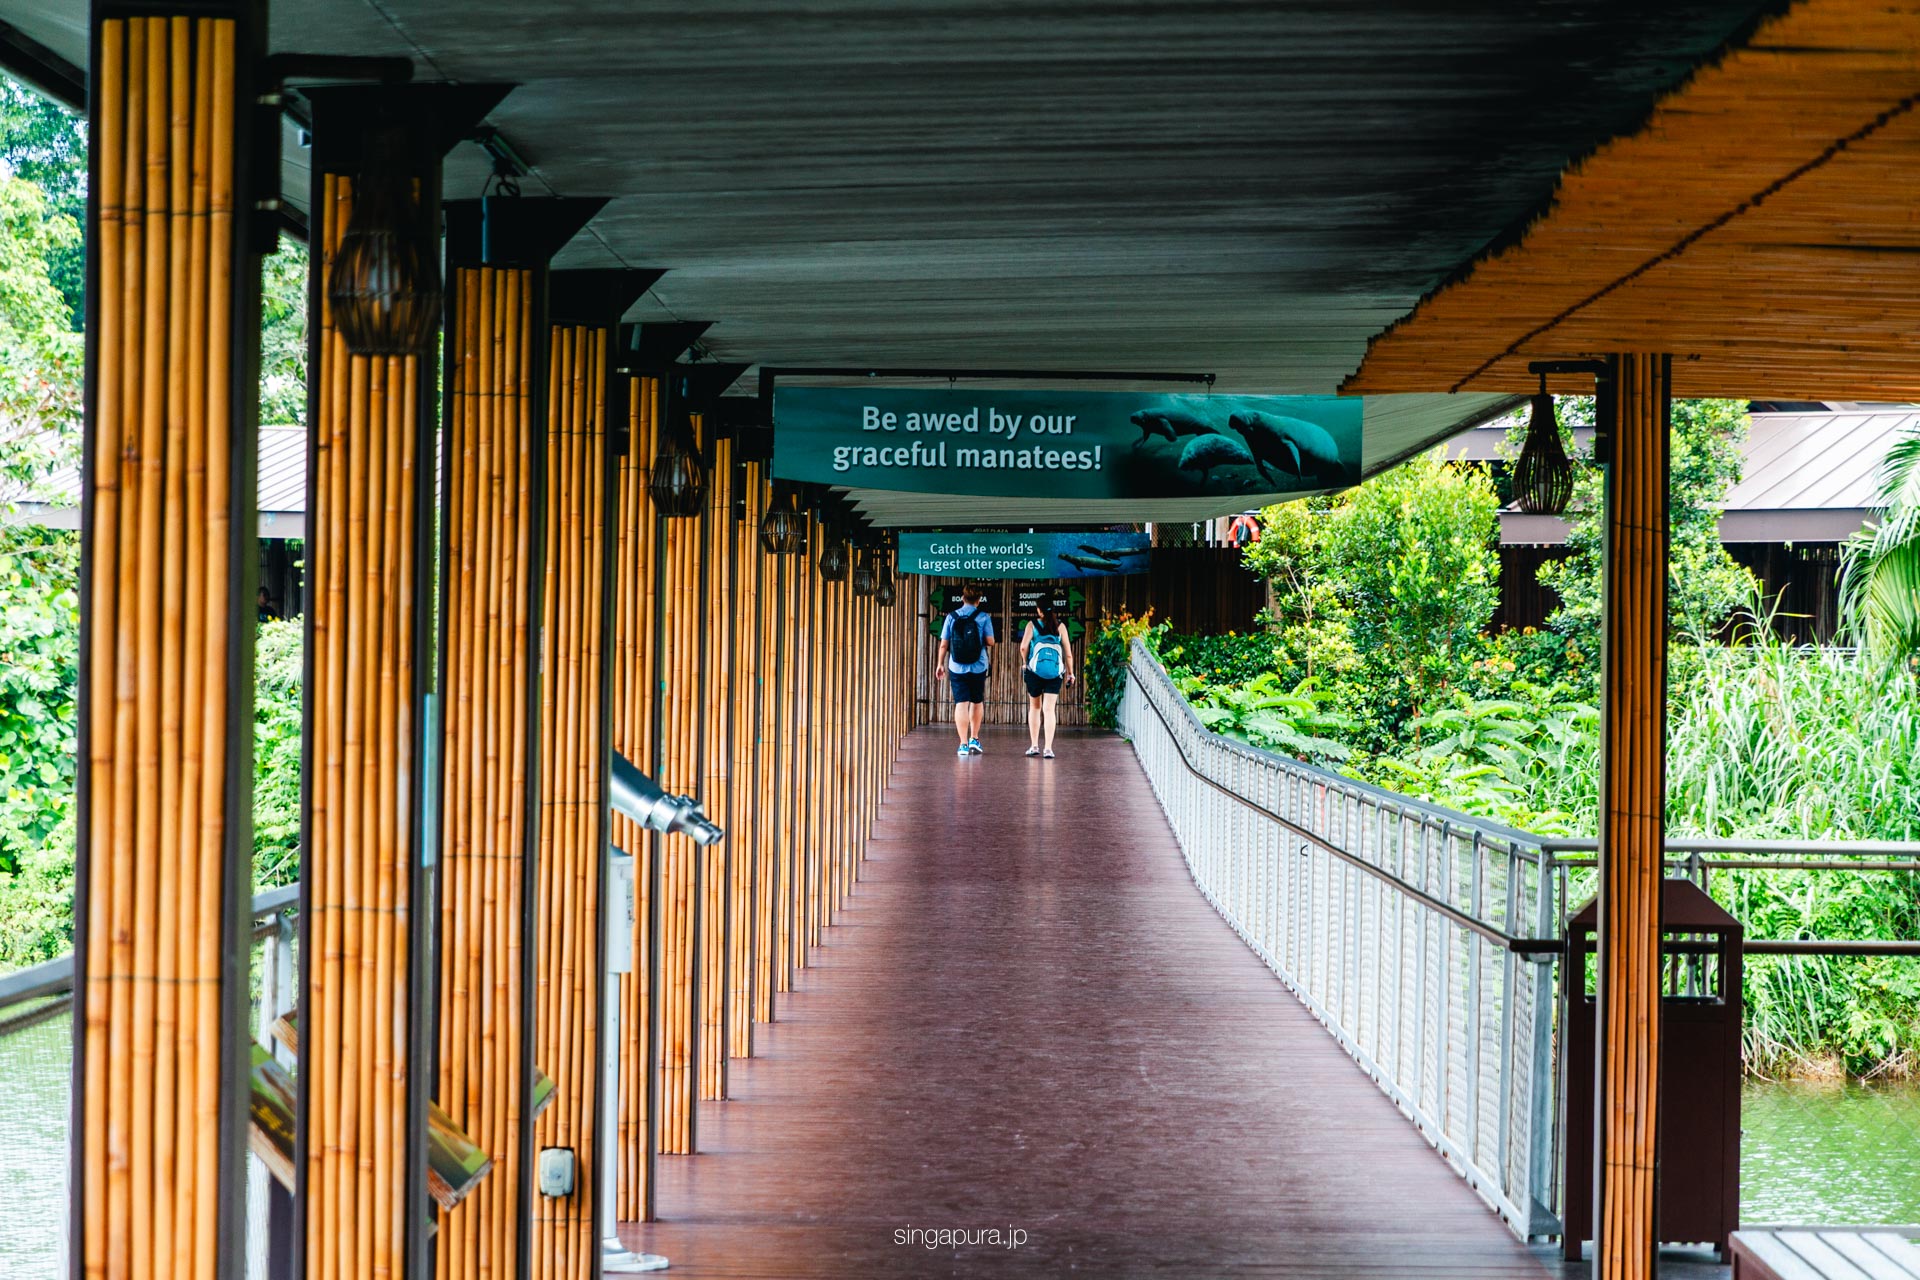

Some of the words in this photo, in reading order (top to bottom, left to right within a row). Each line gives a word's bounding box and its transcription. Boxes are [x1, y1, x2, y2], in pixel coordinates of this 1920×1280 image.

[863, 406, 897, 431] Be
[905, 407, 979, 433] awed
[989, 407, 1022, 440] by
[1029, 413, 1076, 434] our
[833, 441, 947, 471] graceful
[956, 444, 1101, 470] manatees!
[930, 543, 964, 555] Catch
[967, 543, 987, 555] the
[989, 543, 1034, 555] world's
[918, 558, 961, 572] largest
[964, 559, 993, 570] otter
[995, 558, 1045, 572] species!
[1052, 599, 1067, 607] REST
